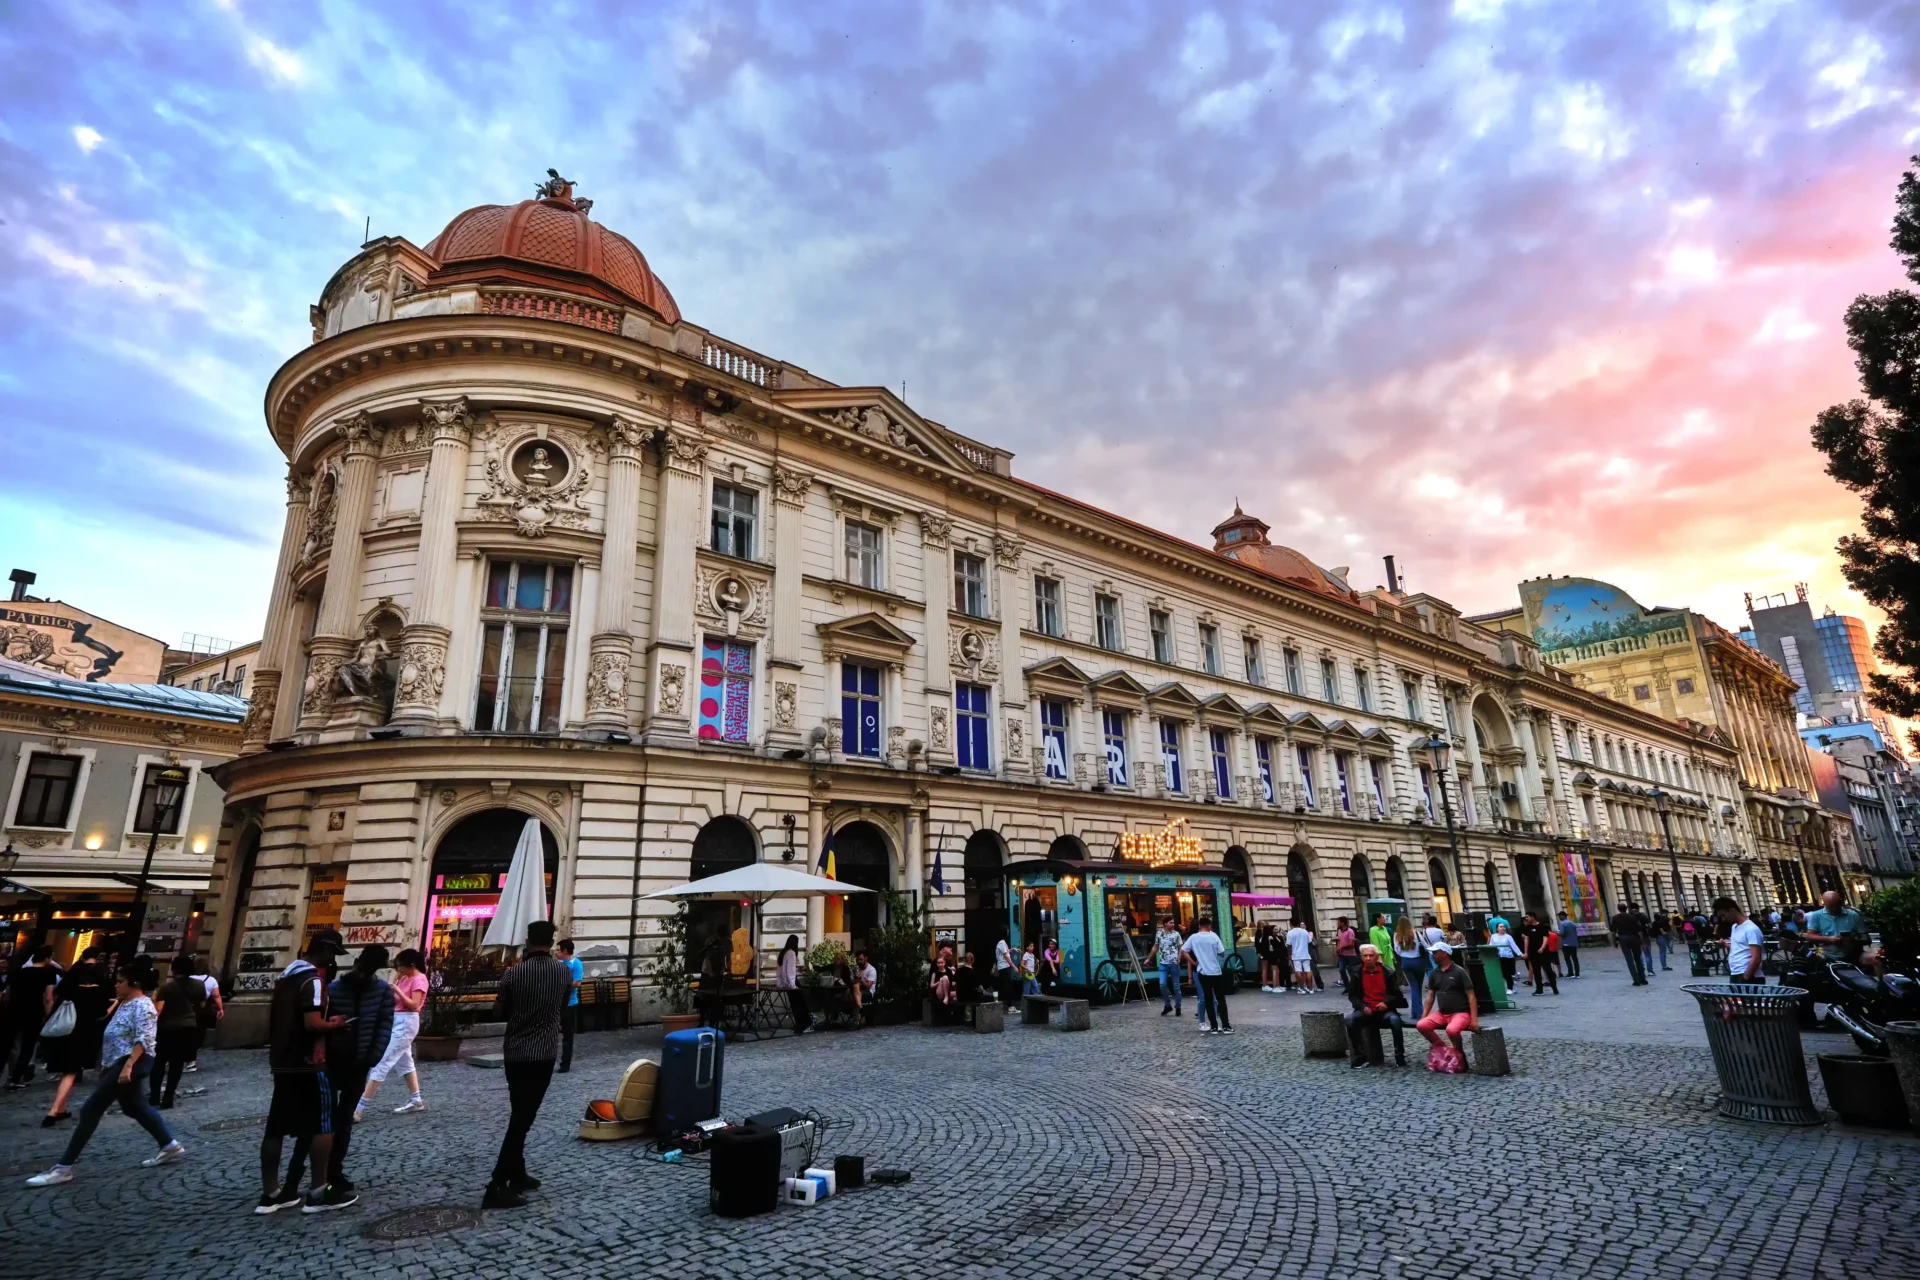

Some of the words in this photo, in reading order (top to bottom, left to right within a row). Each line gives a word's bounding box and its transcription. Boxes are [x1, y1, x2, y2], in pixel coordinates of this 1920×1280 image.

[6, 610, 76, 629] PATRICK
[441, 908, 457, 917] BOB
[461, 907, 493, 916] GEORGE
